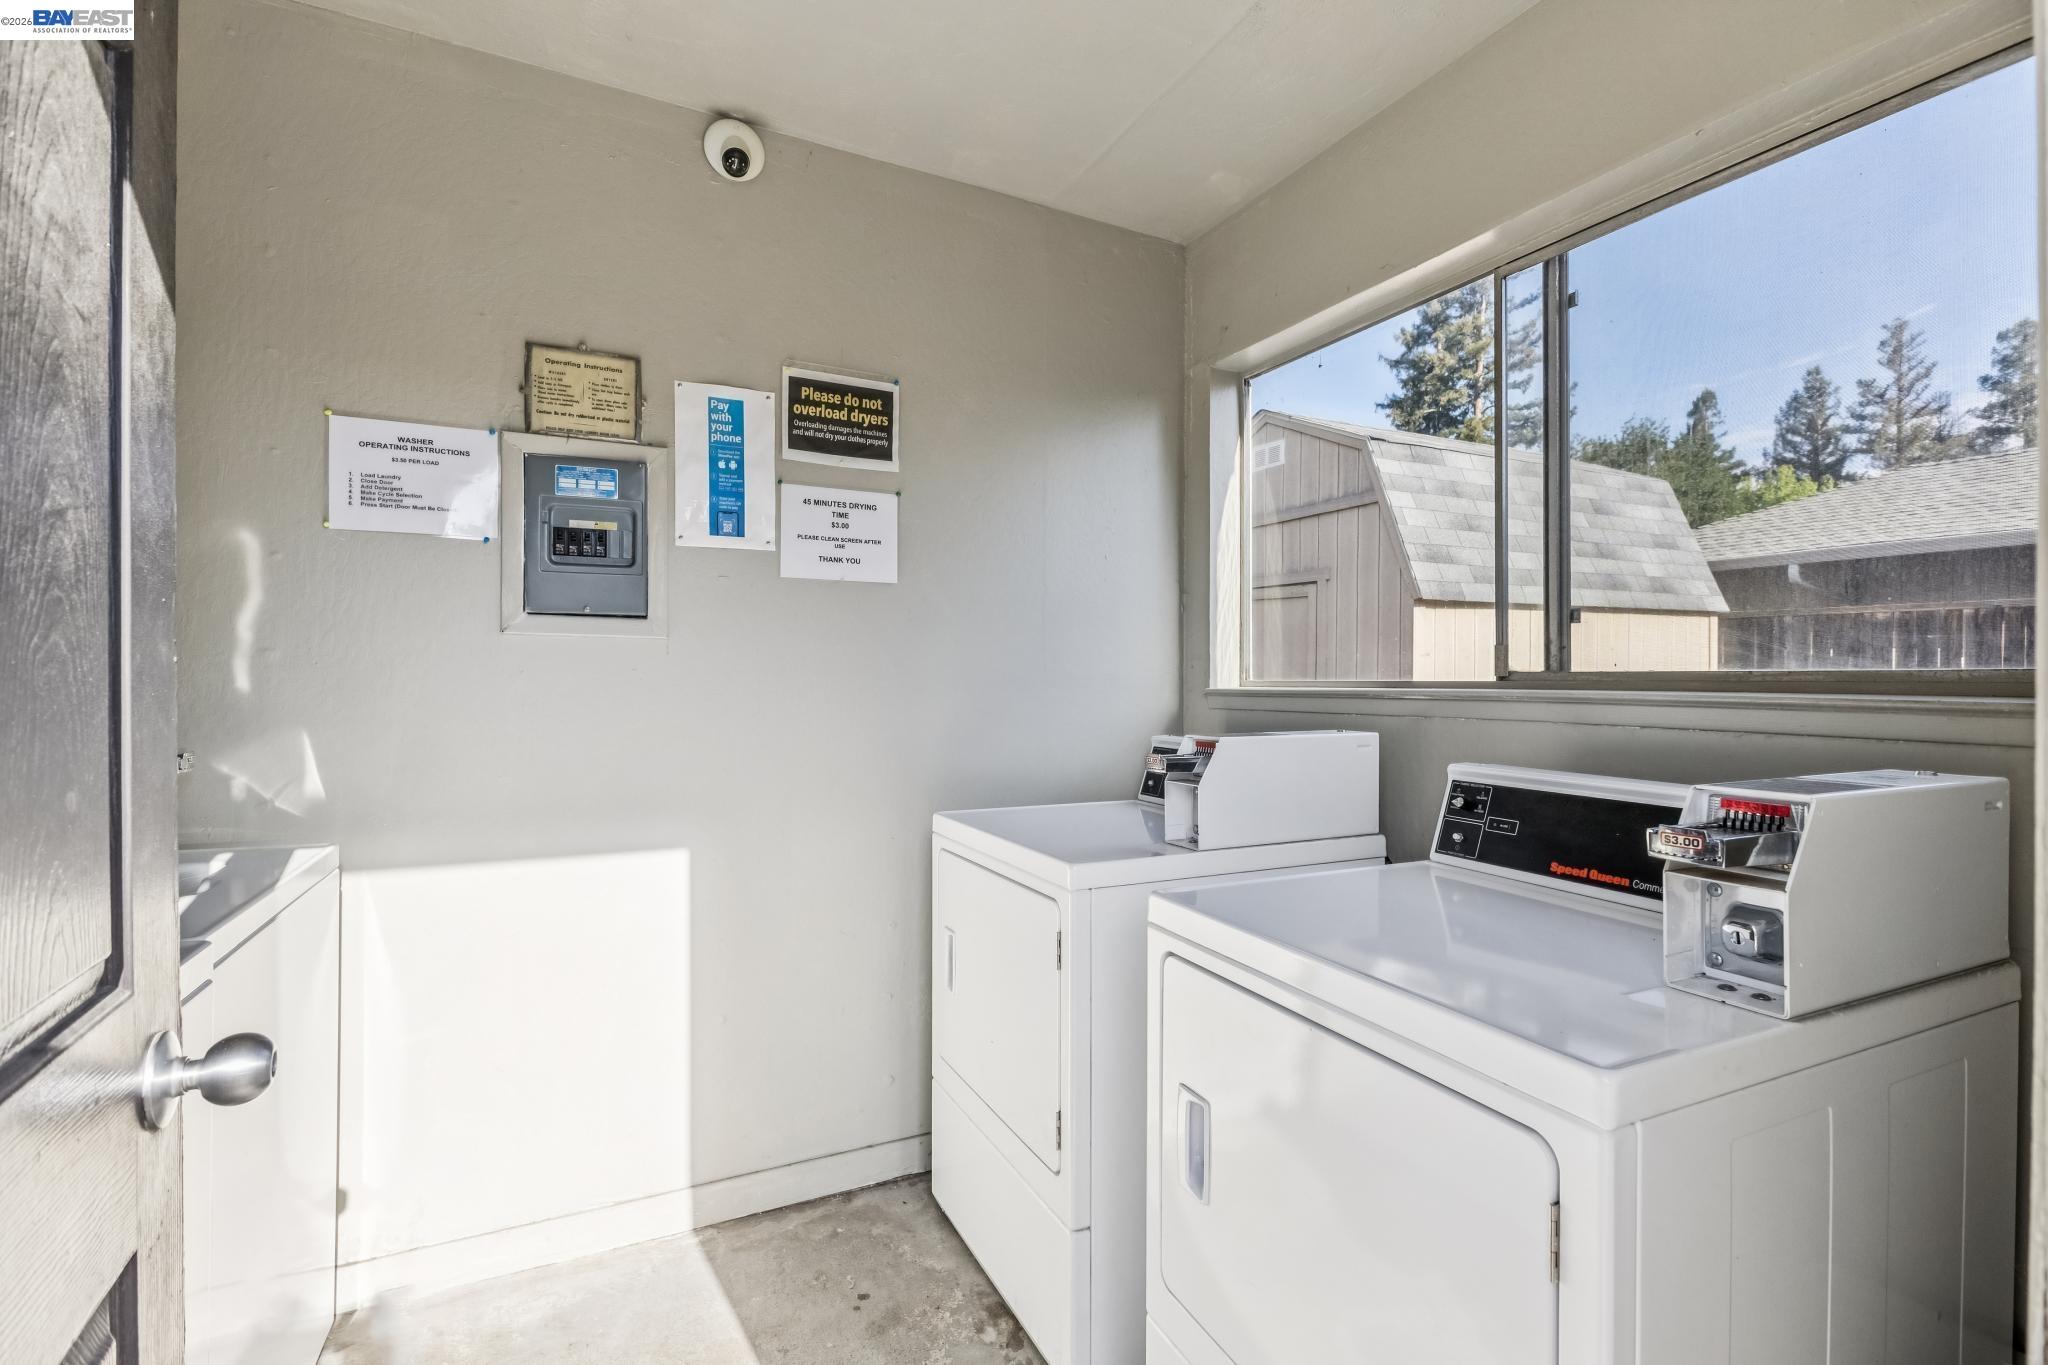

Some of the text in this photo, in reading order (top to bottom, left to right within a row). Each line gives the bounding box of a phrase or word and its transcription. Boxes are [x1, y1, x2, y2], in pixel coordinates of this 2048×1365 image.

[545, 358, 623, 374] Operating Instructions
[801, 387, 882, 410] Please do not
[711, 400, 729, 412] Pay
[711, 412, 731, 422] with
[794, 404, 888, 426] overload dryers
[711, 422, 733, 432] your
[794, 420, 827, 431] Overloading
[828, 424, 852, 434] damages
[863, 430, 887, 438] machines
[397, 436, 434, 446] WASHER
[711, 432, 741, 443] phone
[848, 435, 866, 444] clothes
[867, 438, 888, 448] properly
[358, 441, 470, 457] OPERATING INSTRUCTIONS
[814, 500, 847, 508] MINUTES
[849, 502, 877, 511] DRYING
[1550, 861, 1588, 878] Speed
[1589, 870, 1630, 887] Queen
